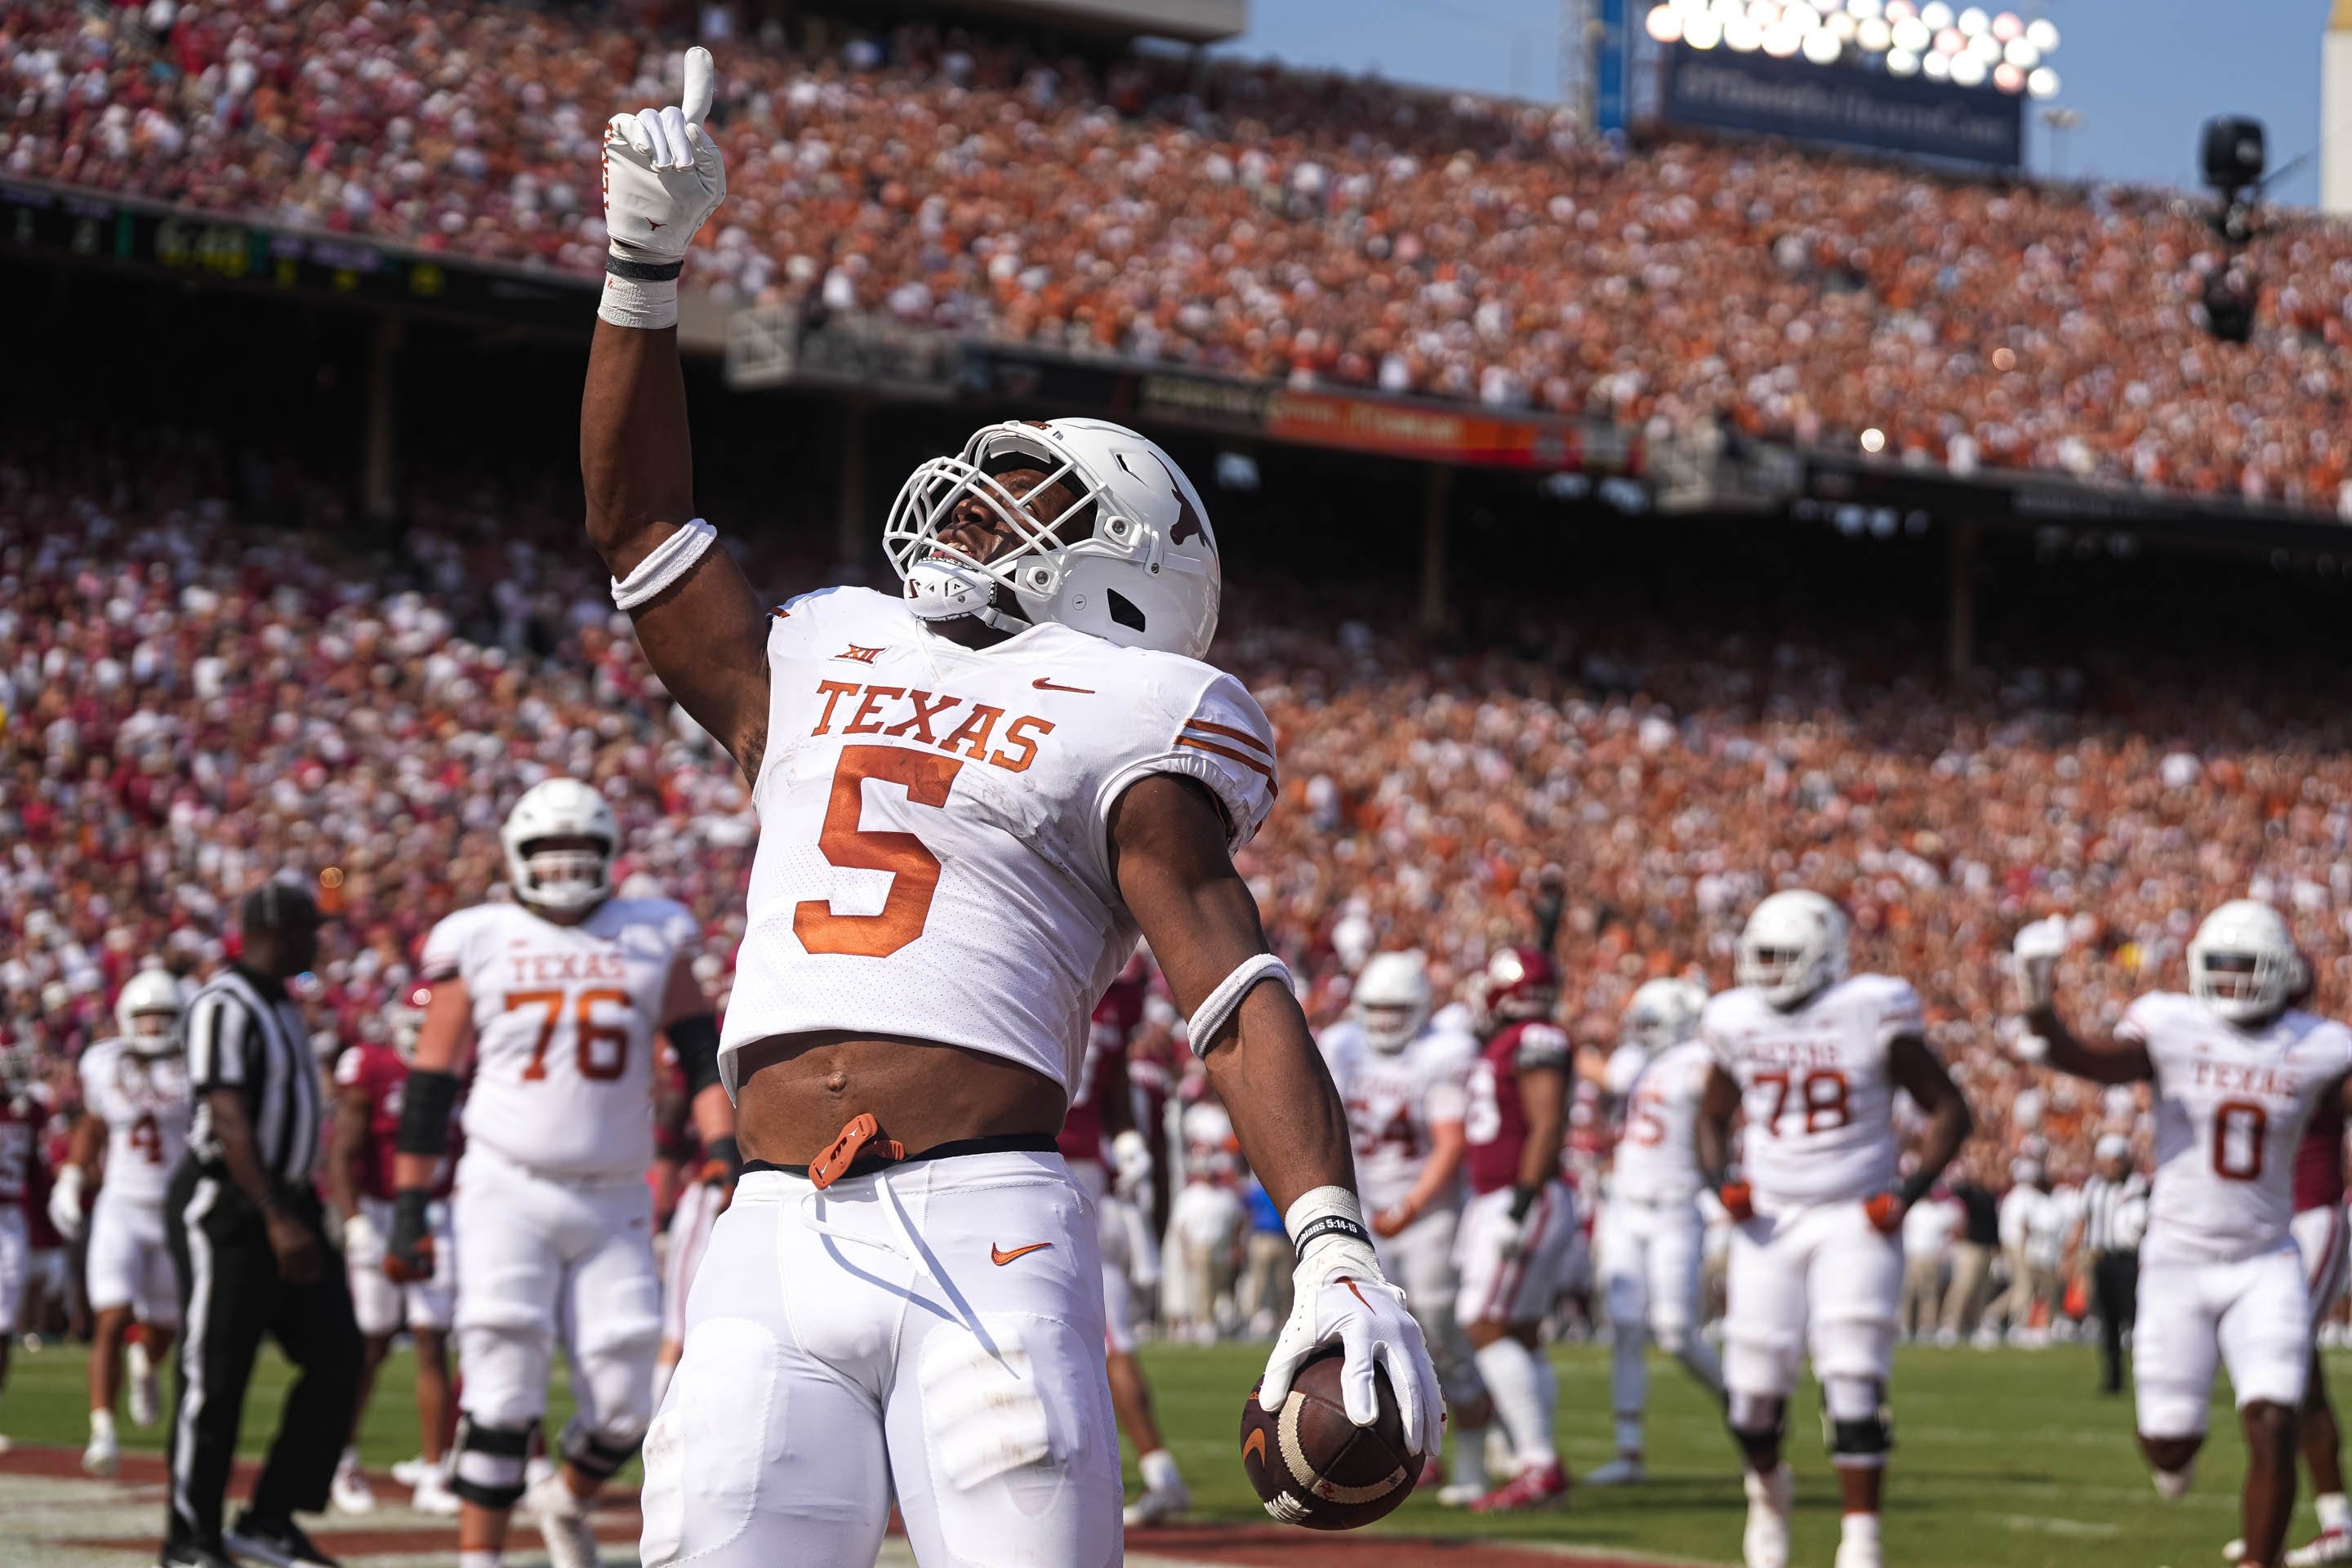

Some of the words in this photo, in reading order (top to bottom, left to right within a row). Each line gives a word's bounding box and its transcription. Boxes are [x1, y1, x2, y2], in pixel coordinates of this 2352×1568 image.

[835, 644, 887, 665] XII
[811, 679, 1055, 773] TEXAS
[793, 745, 964, 958] 5
[510, 953, 626, 982] TEXAS
[504, 988, 634, 1081] 76
[1751, 1069, 1852, 1136] 78
[2192, 1059, 2299, 1098] TEXAS
[131, 1111, 163, 1163] 4
[2214, 1100, 2267, 1181] 0
[1325, 1218, 1357, 1234] 5:14-15
